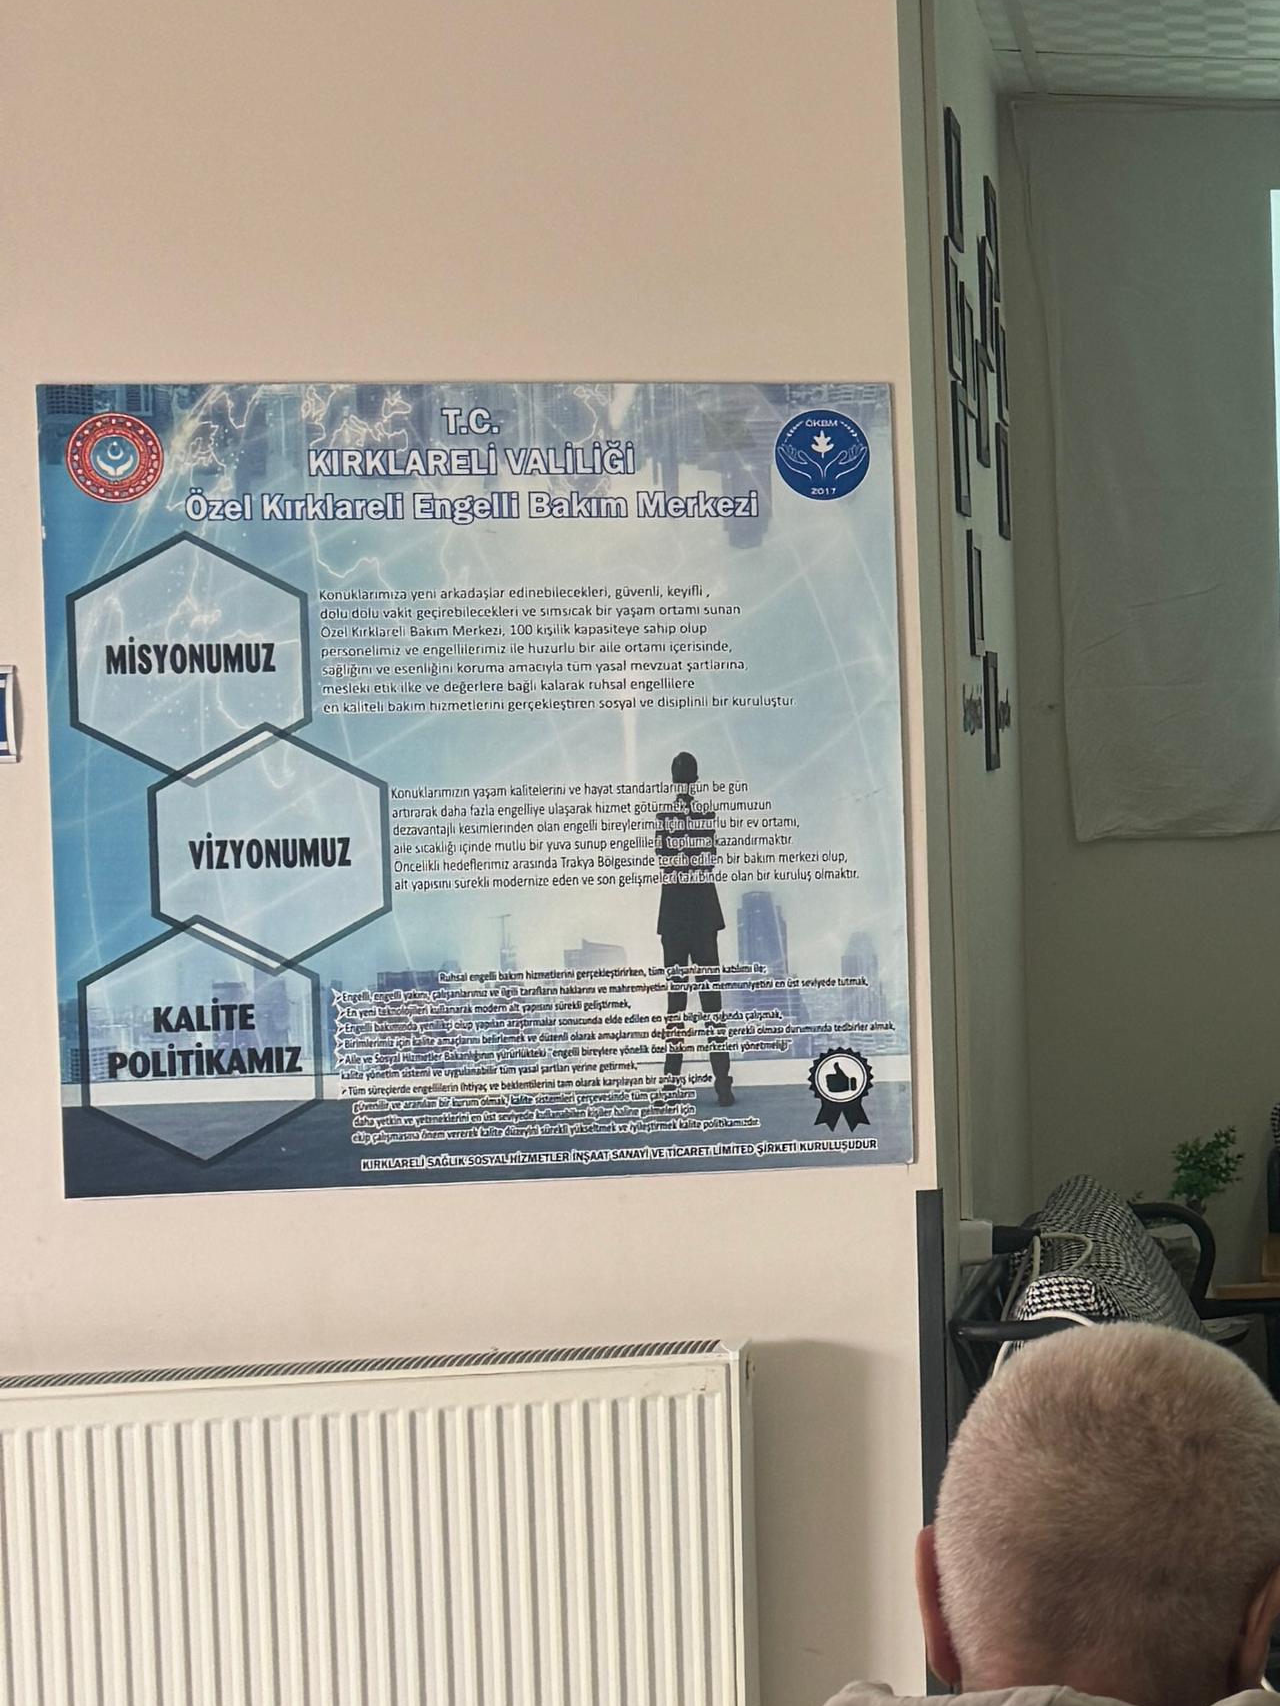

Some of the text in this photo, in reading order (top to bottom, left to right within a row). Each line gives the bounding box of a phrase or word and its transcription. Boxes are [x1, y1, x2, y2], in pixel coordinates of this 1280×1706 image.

[441, 407, 499, 434] T.C.
[308, 440, 636, 477] KIRKLARELİ VALİLİĞİ
[811, 487, 836, 495] 2017
[185, 487, 758, 525] Özel Kırklareli Engelli Bakım Merkezi
[320, 584, 702, 603] Konuklarımıza yeni arkadaşlar edinebilecekleri, güvenli, keyifli
[320, 604, 741, 622] dolu dolu vakit geçirebilecekleri ve sımsıcak bir yaşam ortamı sunan
[321, 622, 707, 641] Özel Kırklareli Bakım Merkezi, 100 kişilik kapasiteye sahip olup
[106, 636, 276, 675] MİSYONUMUZ
[322, 641, 732, 659] personelimiz ve engellilerimiz ile huzurlu bir aile ortamı içerisinde,
[322, 660, 748, 678] sağlığını ve esenliğini koruma amacıyla tüm yasal mevzuat şartlarına,
[322, 677, 694, 697] mesleki etik ilke ve değerlere bağlı kalarak ruhsal engellilere
[324, 695, 796, 716] en kaliteli bakım hizmetlerini gerçekleştiren sosyal ve disiplinli bir kuruluştur.
[391, 786, 469, 801] Konuklarımızın
[472, 787, 506, 799] yaşam
[510, 783, 565, 796] kalitelerini
[567, 785, 582, 796] ve
[584, 783, 614, 796] hayat
[690, 782, 709, 794] gün
[712, 780, 725, 792] be
[728, 780, 748, 794] gün
[393, 806, 437, 818] artırarak
[440, 805, 466, 816] daha
[470, 803, 494, 816] fazla
[497, 803, 545, 818] engelliye
[548, 802, 592, 816] ulaşarak
[595, 802, 631, 813] hizmet
[189, 832, 351, 869] VİZYONUMUZ
[153, 997, 255, 1033] KALİTE
[107, 1042, 303, 1078] POLİTİKAMIZ
[363, 1155, 424, 1169] KIRKLARELİ
[428, 1153, 466, 1167] SAĞLIK
[468, 1154, 508, 1165] SOSYAL
[510, 1150, 570, 1163] HİZMETLER
[572, 1148, 609, 1163] İNŞAAT
[650, 1147, 665, 1159] VE
[666, 1144, 711, 1157] TİCARET
